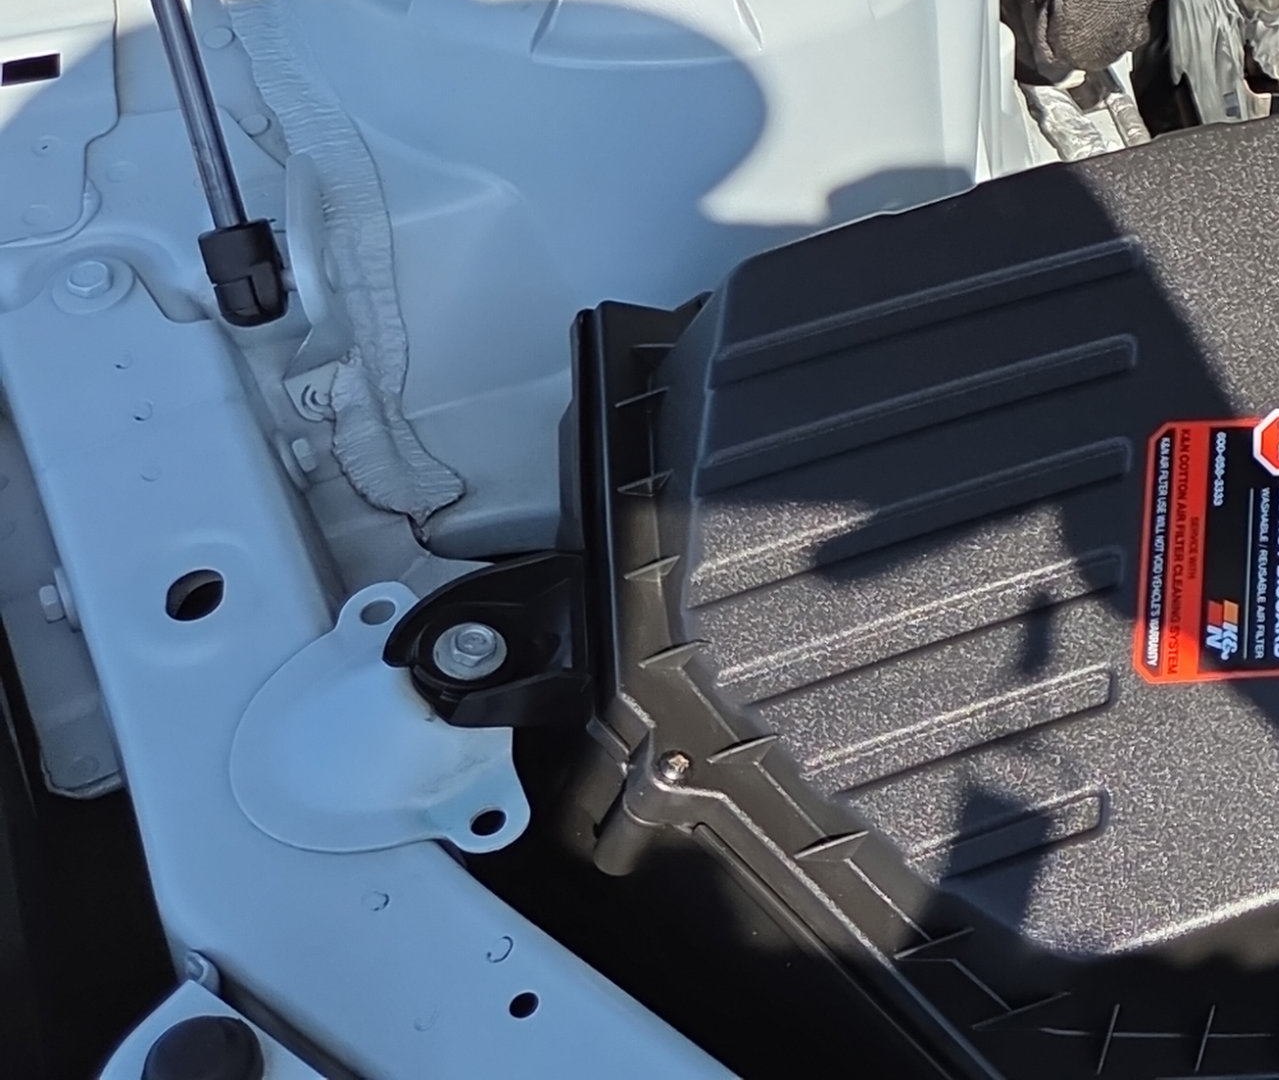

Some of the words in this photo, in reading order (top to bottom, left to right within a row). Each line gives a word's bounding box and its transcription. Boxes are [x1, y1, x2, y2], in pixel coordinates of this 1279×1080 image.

[1160, 437, 1170, 455] K&N
[1179, 429, 1190, 452] K&N
[1159, 456, 1169, 469] AIR
[1157, 470, 1169, 496] FILTER
[1176, 455, 1189, 501] COTTON
[1156, 498, 1167, 514] USE
[1176, 503, 1186, 522] AIR
[1259, 488, 1270, 542] WASHABLE
[1155, 515, 1166, 534] WILL
[1189, 516, 1200, 554] SERVICE
[1154, 536, 1165, 553] NOT
[1173, 524, 1185, 562] FILTER
[1153, 555, 1164, 573] VOID
[1188, 556, 1198, 579] WITH
[1256, 549, 1267, 603] REUSABLE
[1150, 575, 1163, 616] VEHICLE'S
[1170, 565, 1184, 623] CLEANING
[1256, 606, 1266, 622] AIR
[1147, 619, 1160, 666] WARRANTY
[1167, 626, 1181, 674] SYSTEM
[1254, 624, 1265, 659] FILTER
